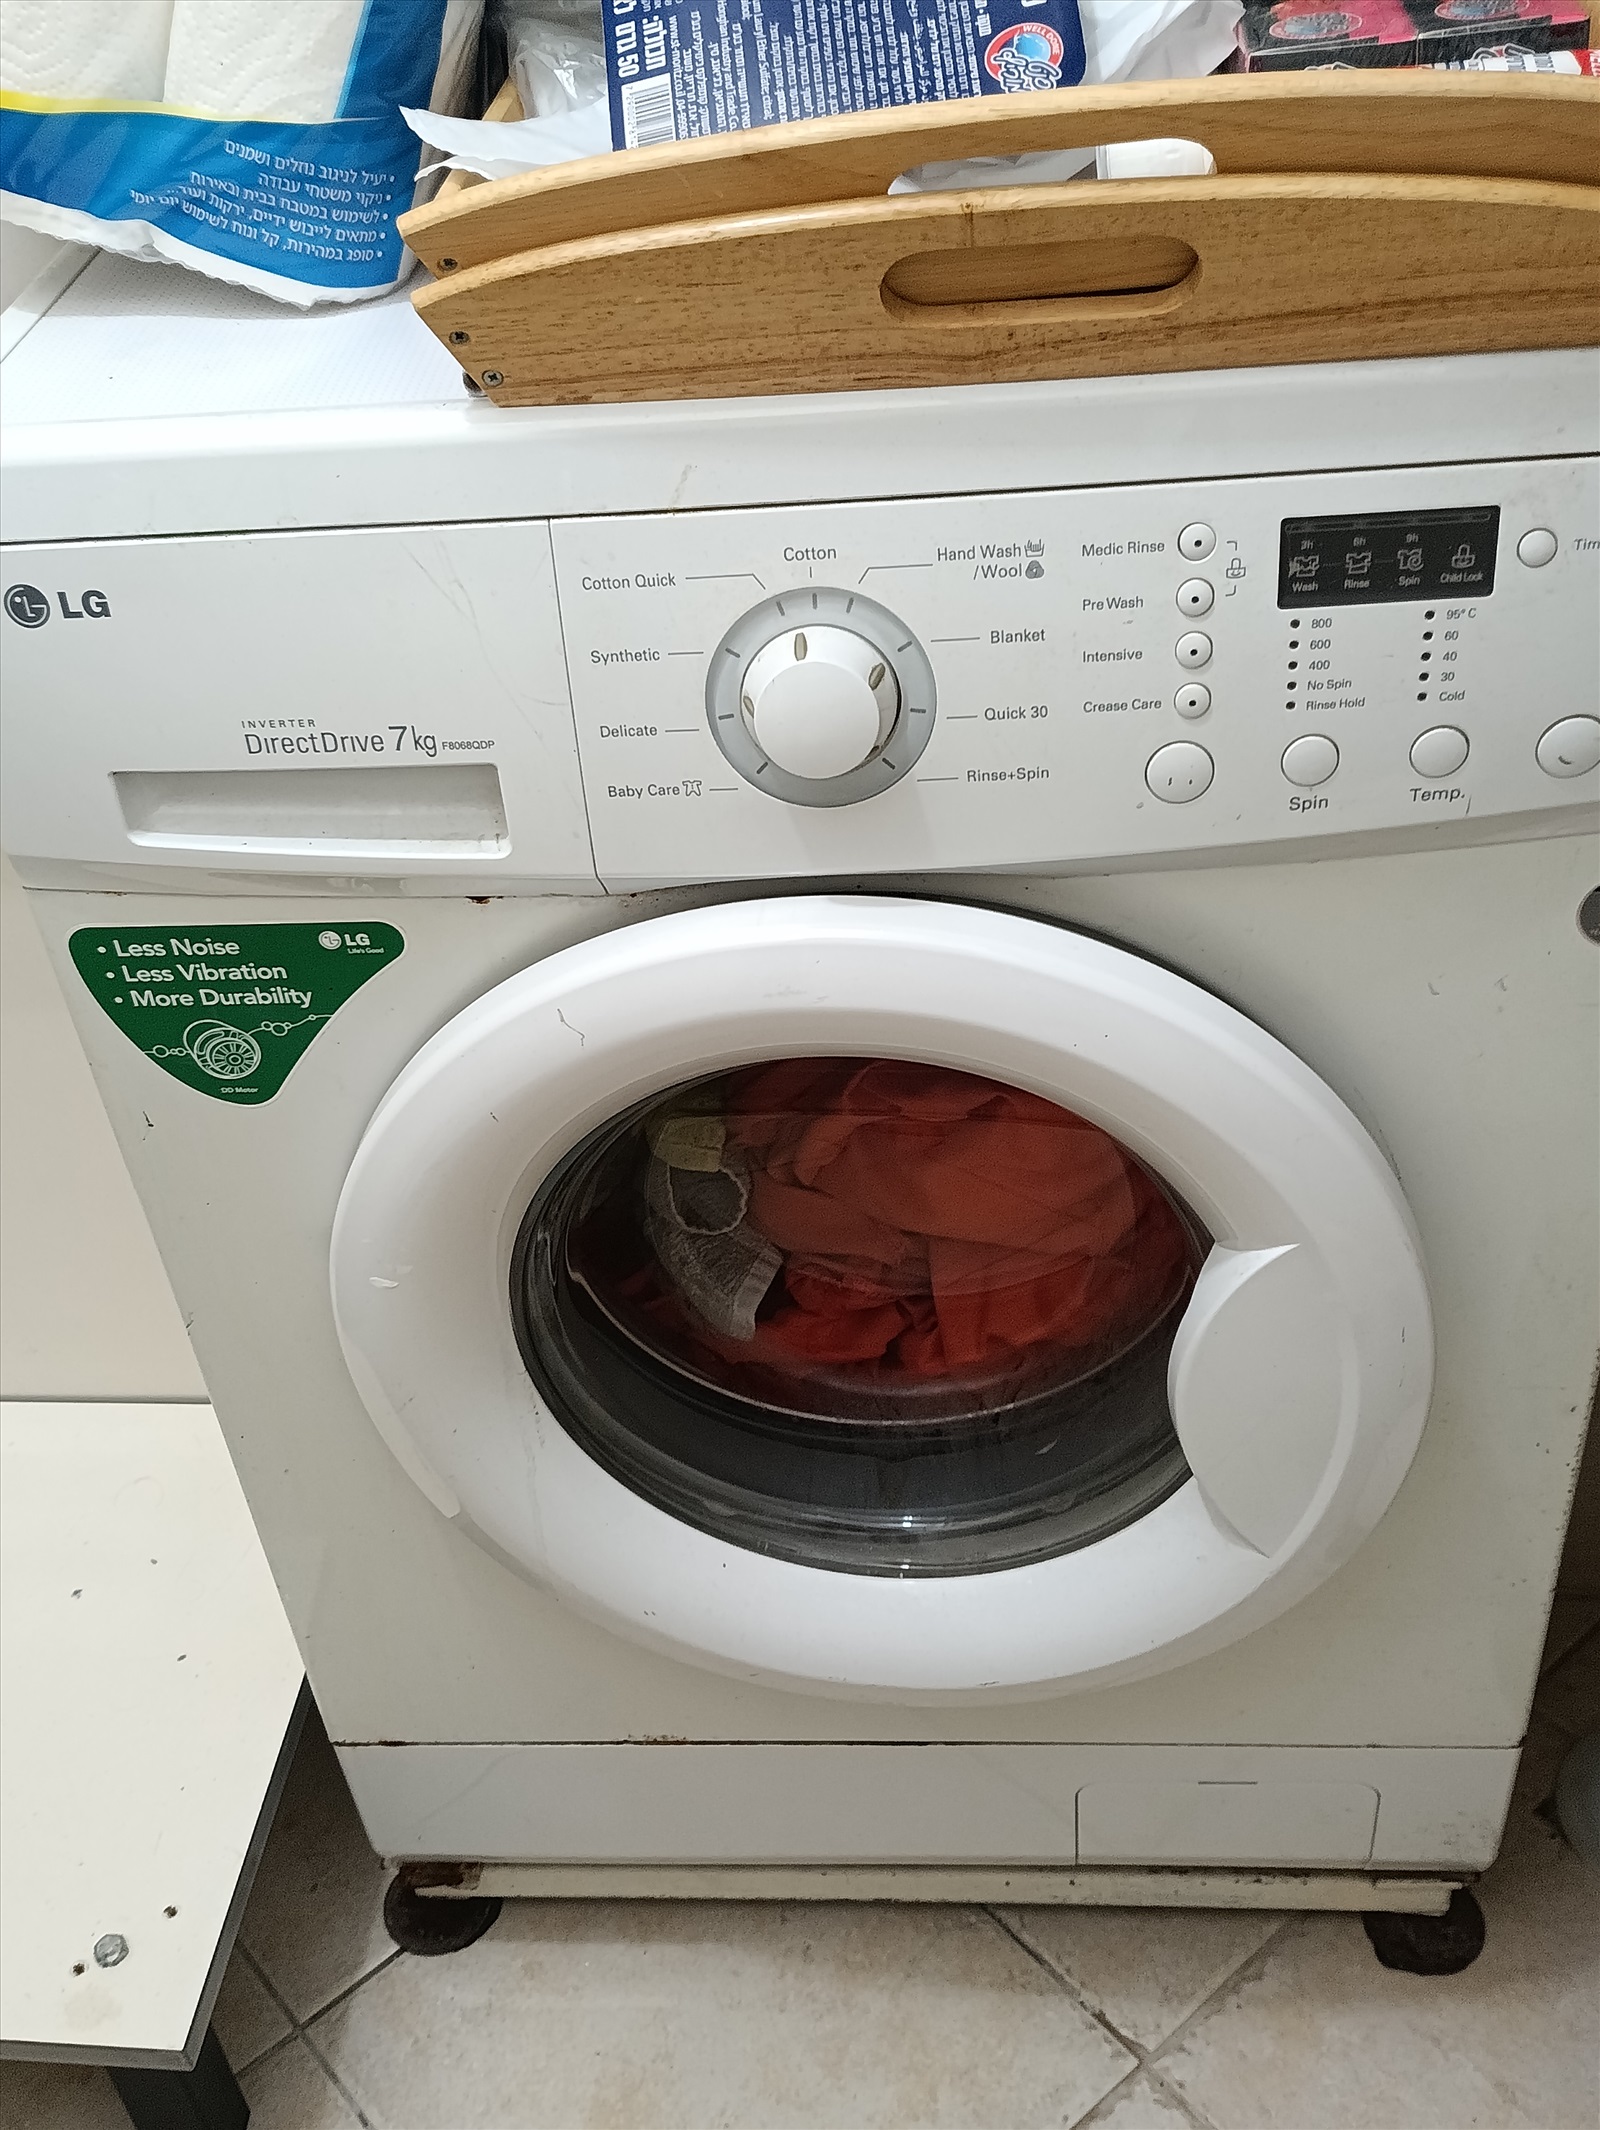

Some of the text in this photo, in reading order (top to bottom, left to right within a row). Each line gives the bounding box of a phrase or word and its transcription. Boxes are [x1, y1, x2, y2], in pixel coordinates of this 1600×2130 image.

[614, 20, 637, 54] גרם
[642, 14, 670, 70] תכולה:
[1022, 24, 1061, 56] WELL DONE
[617, 53, 639, 77] 50
[723, 72, 735, 90] and
[725, 88, 738, 115] Trade
[224, 139, 387, 187] יעיל לניגוב נוזלים ושמנים
[243, 186, 277, 208] בבית
[258, 171, 383, 209] ניקוי משטחי עבודה
[208, 193, 245, 216] ירקות
[280, 197, 328, 220] במטבח
[331, 209, 381, 225] לשימוש
[130, 189, 375, 263] סופג במהירות, קל ונוח לשימוש יום יומי
[289, 218, 333, 240] לייבוש
[335, 228, 378, 244] מתאים
[783, 547, 837, 562] Cotton
[937, 543, 1022, 562] Hand Wash
[1081, 540, 1165, 557] Medic Rinse
[973, 563, 1023, 580] /Wool
[582, 572, 677, 591] Cotton Quick
[1292, 570, 1484, 592] Wash Rinse Spin Child Lock
[57, 589, 112, 620] LG
[1082, 596, 1144, 611] Pre Wash
[1311, 617, 1333, 629] 800
[990, 628, 1046, 644] Blanket
[1309, 638, 1331, 650] 600
[1444, 630, 1459, 641] 60
[590, 648, 661, 667] Synthetic
[1082, 648, 1143, 663] Intensive
[1442, 651, 1458, 662] 40
[1308, 659, 1331, 671] 400
[1307, 678, 1352, 691] No Spin
[1440, 671, 1455, 682] 30
[1305, 697, 1366, 711] Rinse Hold
[1438, 690, 1466, 702] Cold
[984, 705, 1049, 721] Quick 30
[1083, 698, 1162, 713] Crease Care
[241, 718, 317, 730] INVERTER
[600, 724, 658, 739] Delicate
[441, 739, 496, 752] F8068QDP
[966, 767, 1050, 783] Rinse+Spin
[607, 783, 681, 800] Baby Care
[1409, 787, 1466, 803] Temp.
[1289, 795, 1329, 813] Spin
[112, 937, 240, 958] Less Noise
[344, 933, 370, 946] LG
[365, 946, 385, 954] Good
[121, 962, 287, 983] Less Vibration
[129, 987, 312, 1009] More Durability
